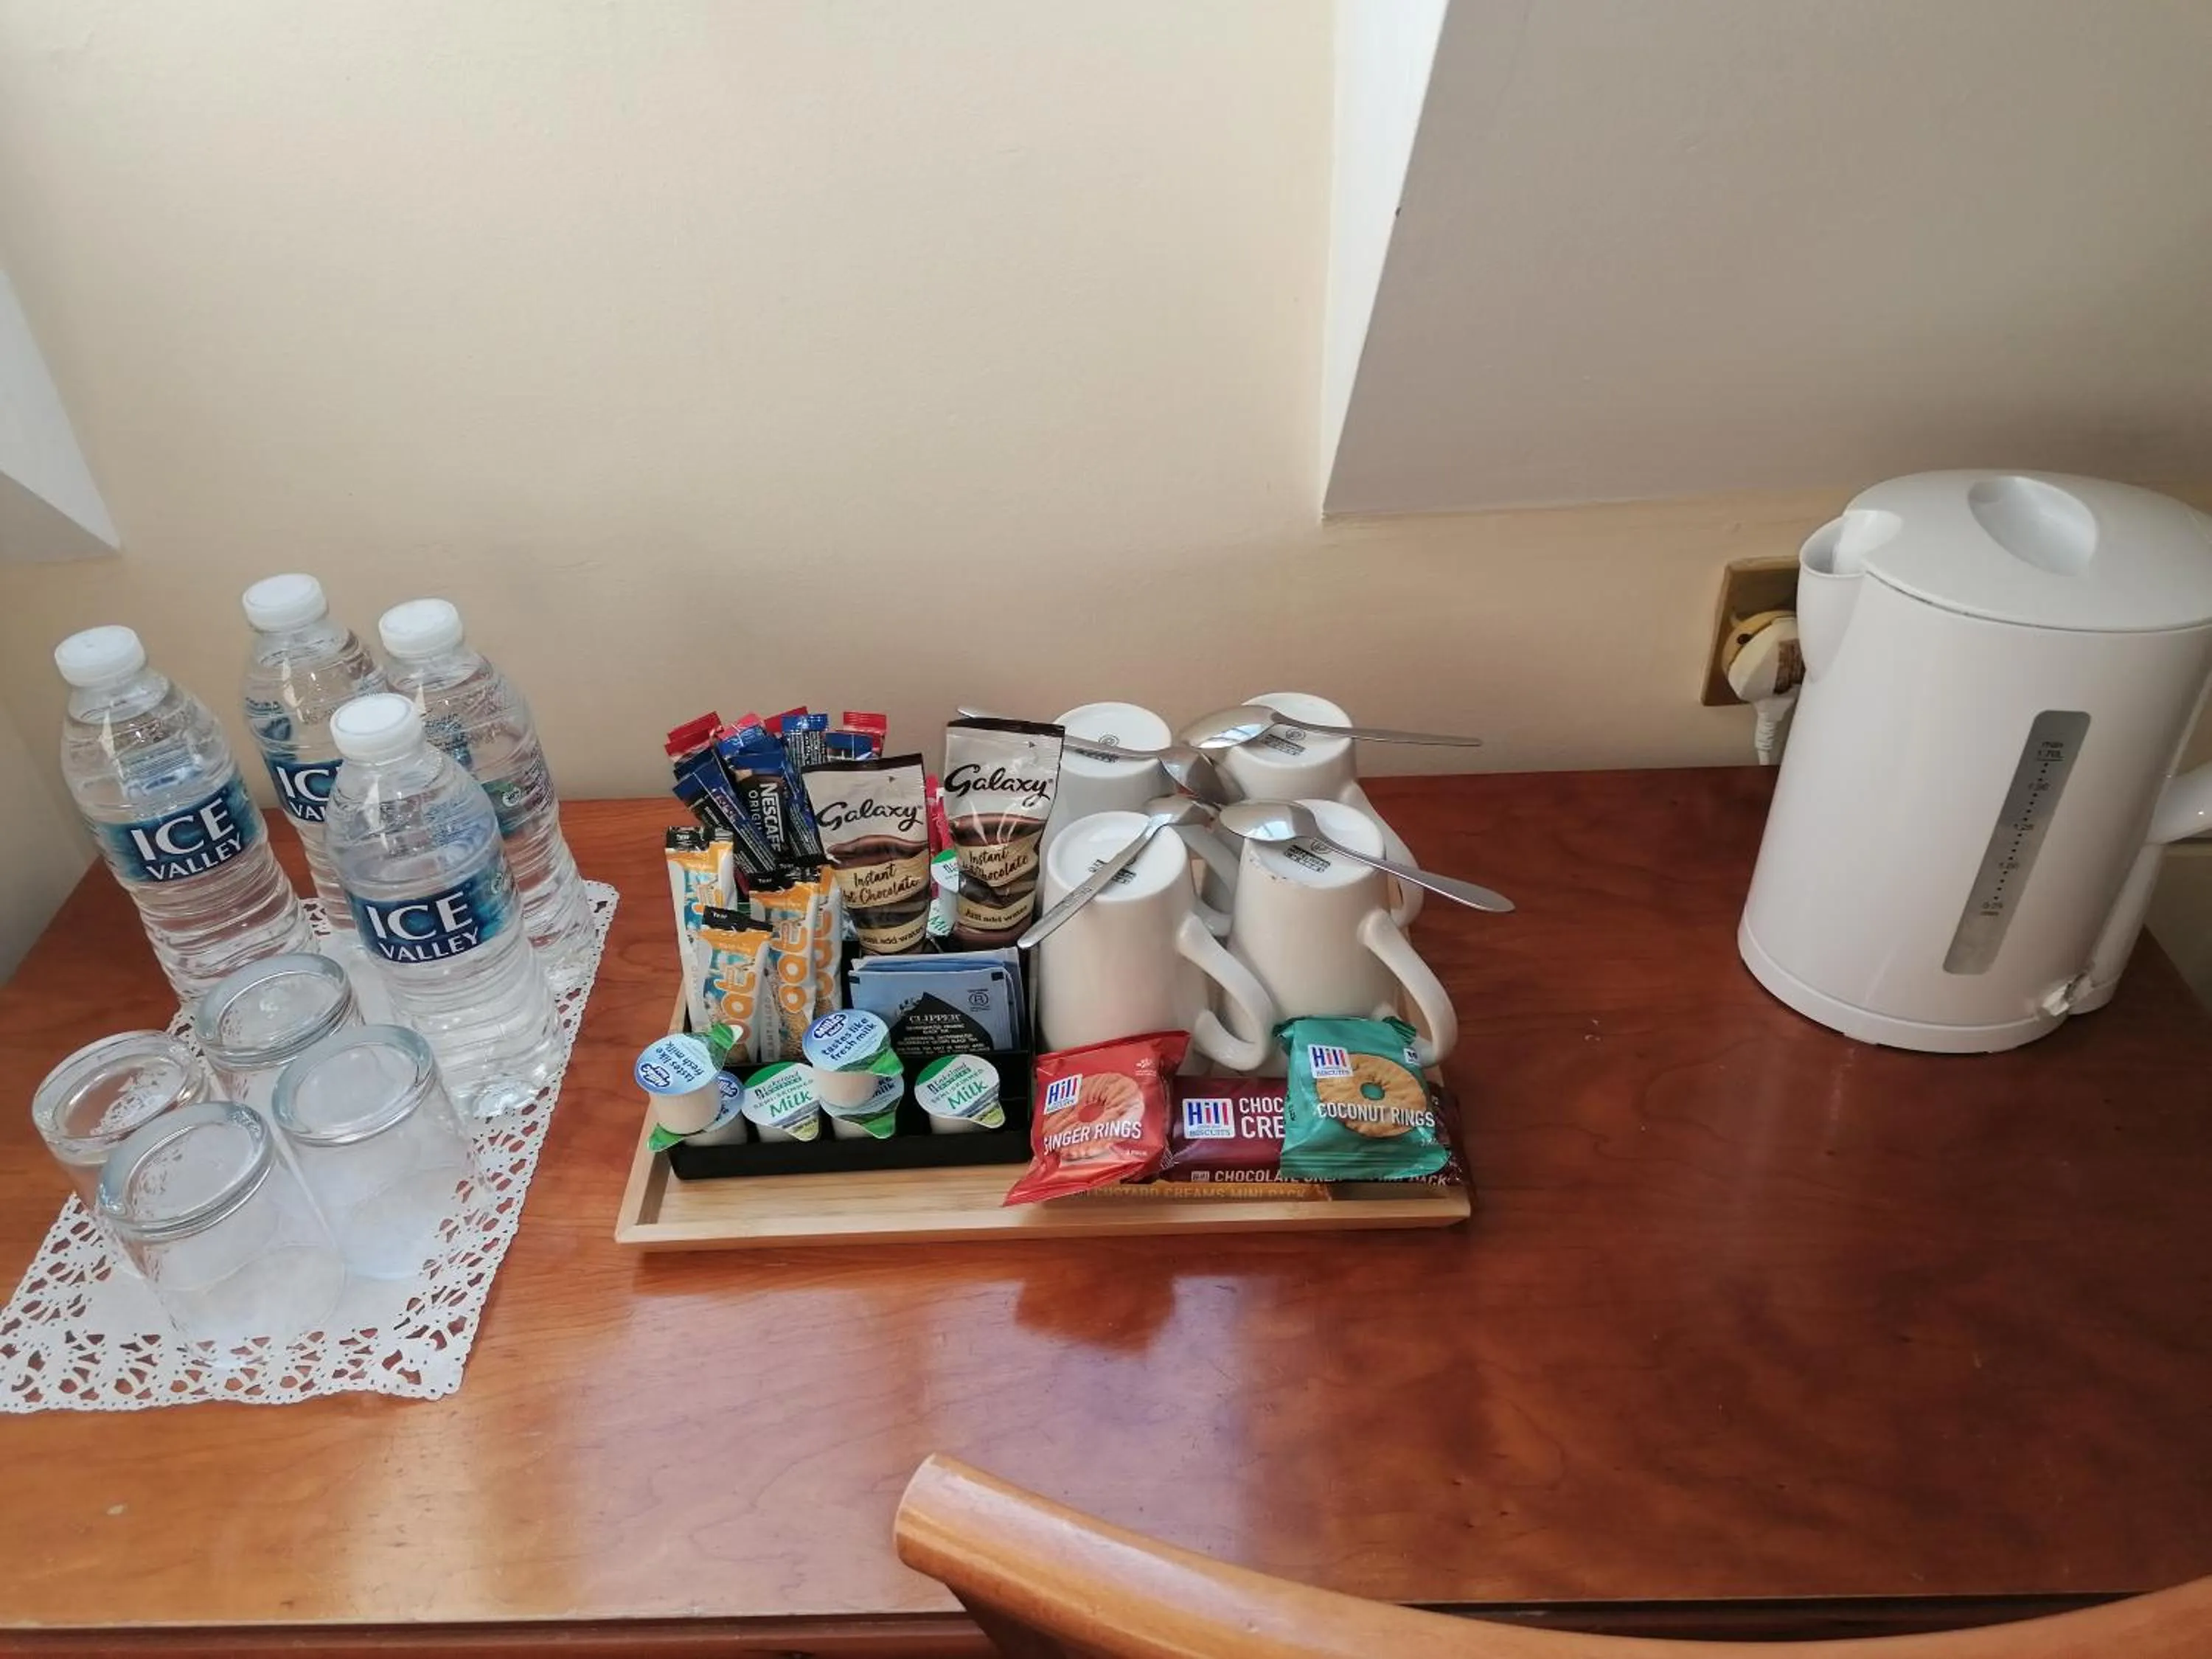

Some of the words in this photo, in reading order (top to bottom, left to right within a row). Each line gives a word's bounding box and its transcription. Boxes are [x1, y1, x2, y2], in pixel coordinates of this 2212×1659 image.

[276, 765, 340, 801] IC
[943, 764, 1051, 808] Galaxy
[748, 789, 762, 830] ORIGI
[816, 799, 925, 832] Galaxy
[131, 798, 234, 861] ICE
[147, 832, 241, 880] VALLEY
[969, 846, 1009, 866] Instant
[853, 863, 897, 887] Instant
[366, 891, 473, 941] ICE
[378, 926, 479, 961] VALLEY
[770, 926, 808, 1013] oat
[665, 1040, 685, 1060] milk
[821, 1032, 852, 1055] tastes
[849, 1018, 869, 1034] like
[830, 1040, 858, 1060] fresh
[856, 1023, 877, 1041] milk
[655, 1047, 672, 1064] like
[682, 1058, 705, 1077] fresh
[1312, 1046, 1348, 1068] Hill
[669, 1061, 695, 1082] tastes
[769, 1091, 813, 1118] Milk
[947, 1081, 988, 1110] Milk
[1048, 1077, 1078, 1105] Hill
[1239, 1096, 1284, 1113] CHOC
[1187, 1102, 1229, 1126] Hill
[1241, 1116, 1286, 1139] CRE
[1317, 1102, 1386, 1122] COCONUT
[1391, 1108, 1436, 1127] RINGS
[1094, 1120, 1142, 1140] RINGS
[1214, 1169, 1299, 1182] CHOCOLA
